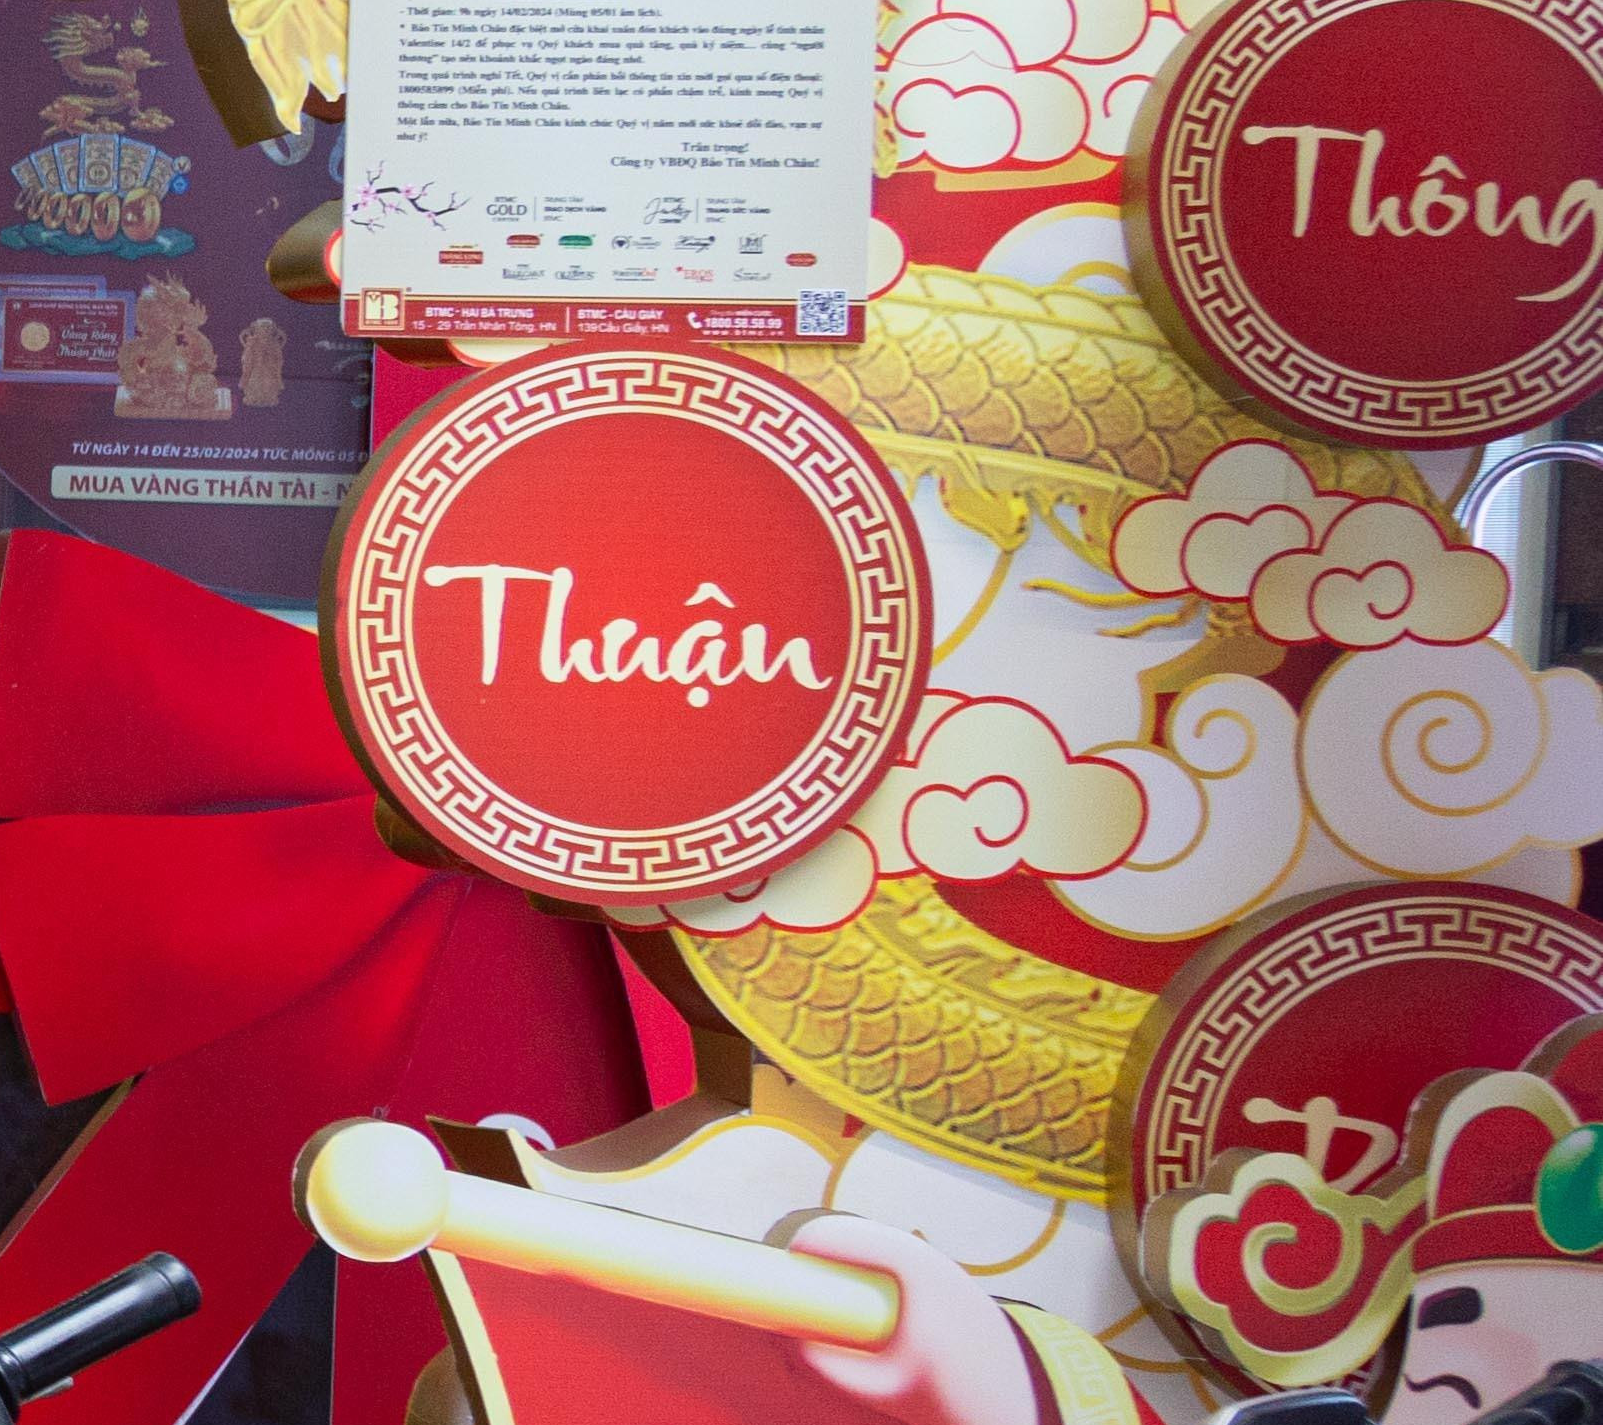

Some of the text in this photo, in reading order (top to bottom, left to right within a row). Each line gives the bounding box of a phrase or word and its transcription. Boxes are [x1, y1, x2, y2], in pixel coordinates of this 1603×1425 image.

[486, 204, 528, 217] GOLD
[1240, 123, 1603, 302] Thông
[412, 321, 426, 331] 15
[437, 321, 452, 331] 29
[539, 323, 558, 333] HN
[133, 444, 150, 456] 14
[182, 445, 259, 461] 25/02/2024
[70, 474, 126, 495] MUA
[130, 473, 199, 497] VÀNG
[278, 477, 315, 500] TÀI
[423, 563, 833, 709] Thuận
